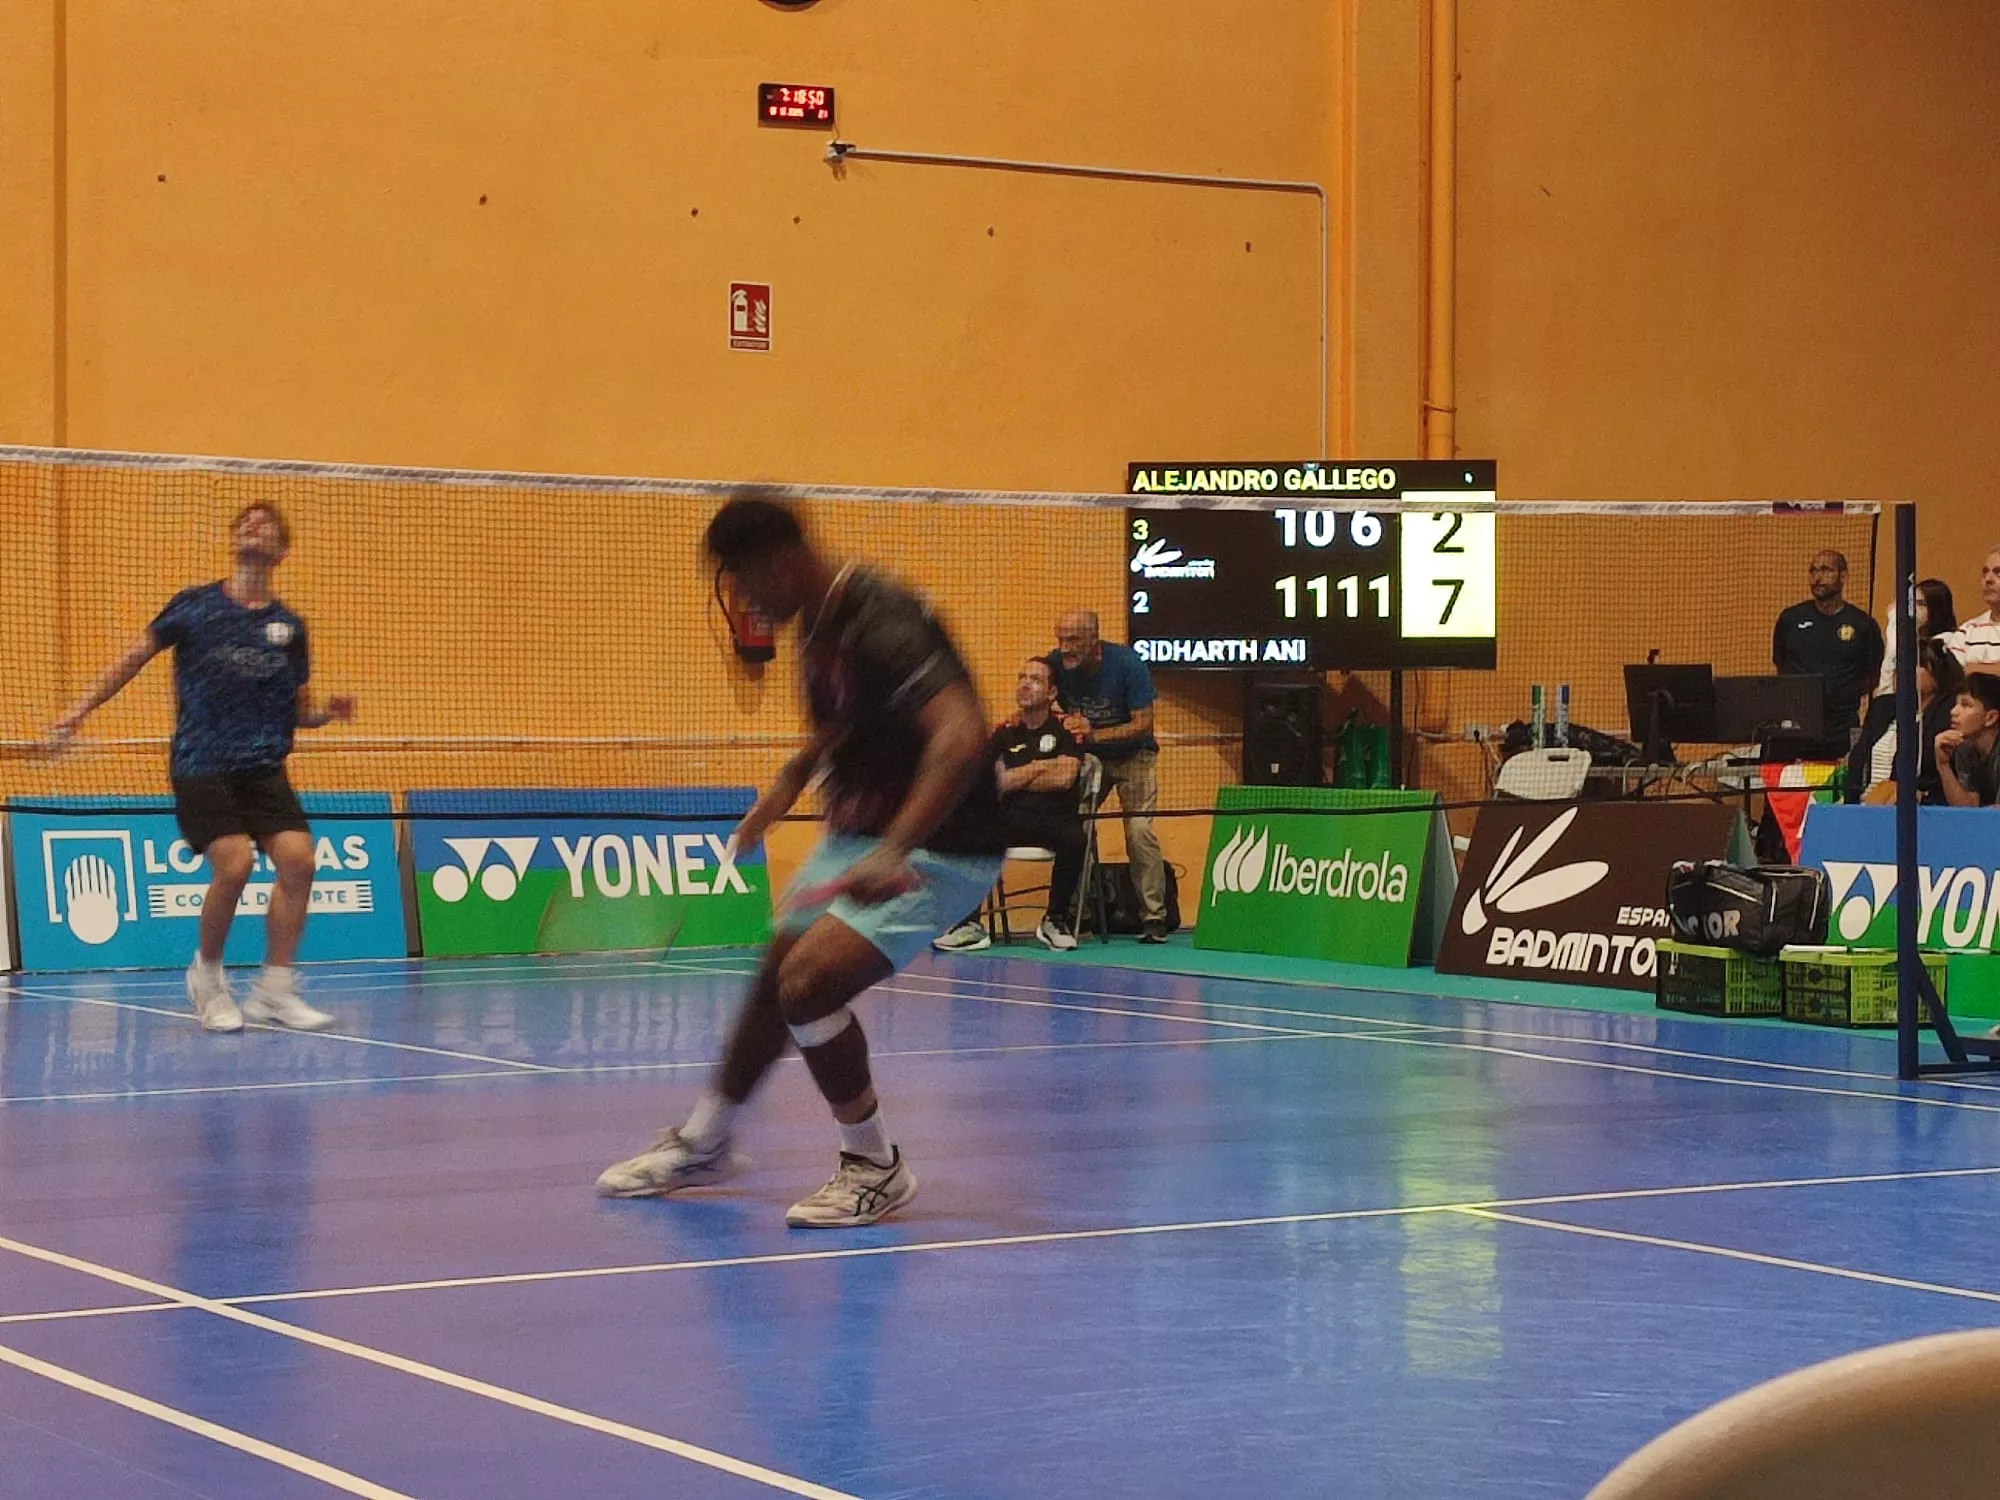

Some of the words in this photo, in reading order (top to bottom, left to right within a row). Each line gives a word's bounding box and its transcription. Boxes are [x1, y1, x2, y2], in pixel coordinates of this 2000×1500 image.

[1132, 469, 1278, 492] ALEJANDRO
[1283, 468, 1396, 491] GALLEGO
[1132, 519, 1149, 541] 3
[1275, 508, 1336, 547] 10
[1350, 510, 1382, 547] 6
[1432, 511, 1465, 553] 2
[1132, 591, 1150, 614] 2
[1432, 579, 1465, 625] 7
[1133, 639, 1258, 662] SIDHARTH
[1262, 639, 1307, 662] ANI
[143, 835, 370, 874] LOAS
[551, 834, 749, 898] YONEX
[1268, 843, 1409, 903] Iberdrola
[255, 890, 348, 907] DRTE
